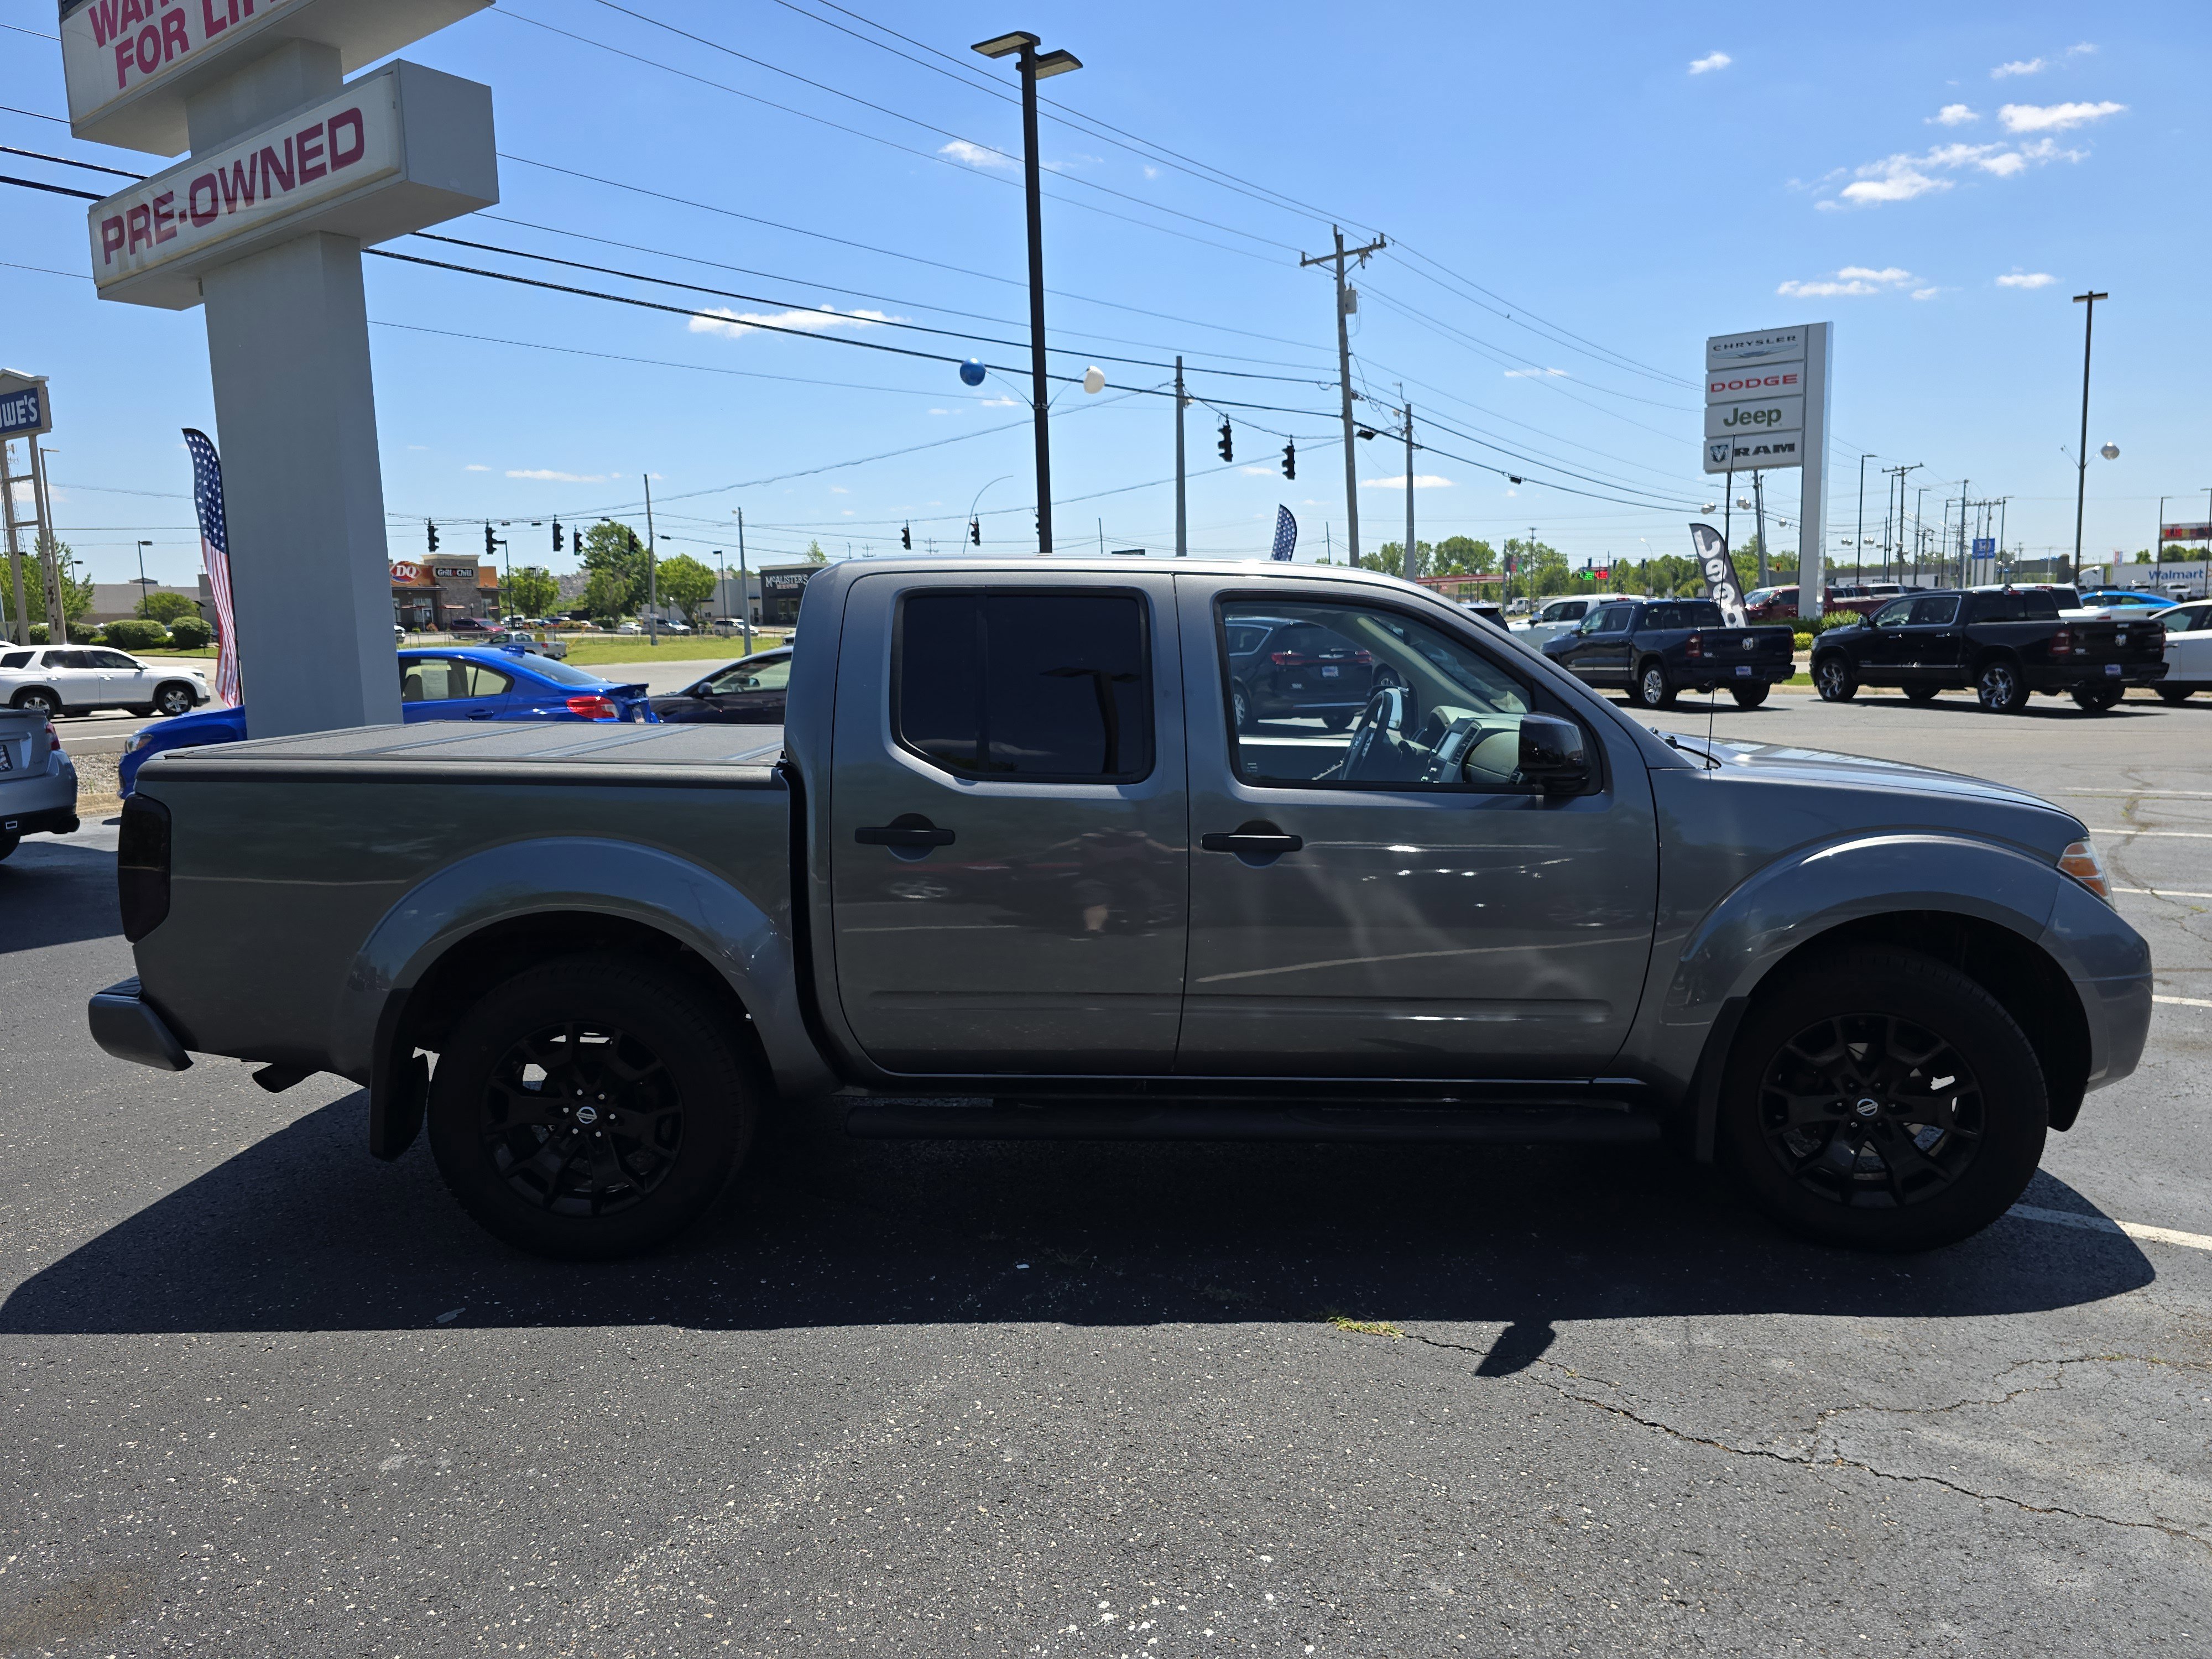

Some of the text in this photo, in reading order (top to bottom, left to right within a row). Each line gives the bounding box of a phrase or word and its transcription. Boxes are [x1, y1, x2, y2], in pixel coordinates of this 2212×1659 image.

[115, 8, 190, 90] FOR
[102, 107, 365, 265] PRE-OWNED
[1713, 335, 1797, 352] CHRYSLER
[1710, 373, 1798, 393] DODGE
[1723, 406, 1782, 427] Jeep
[1734, 442, 1796, 458] RAM
[396, 565, 416, 578] DQ
[437, 568, 452, 577] Grill
[456, 569, 473, 577] Chill
[2148, 568, 2204, 581] Walmart
